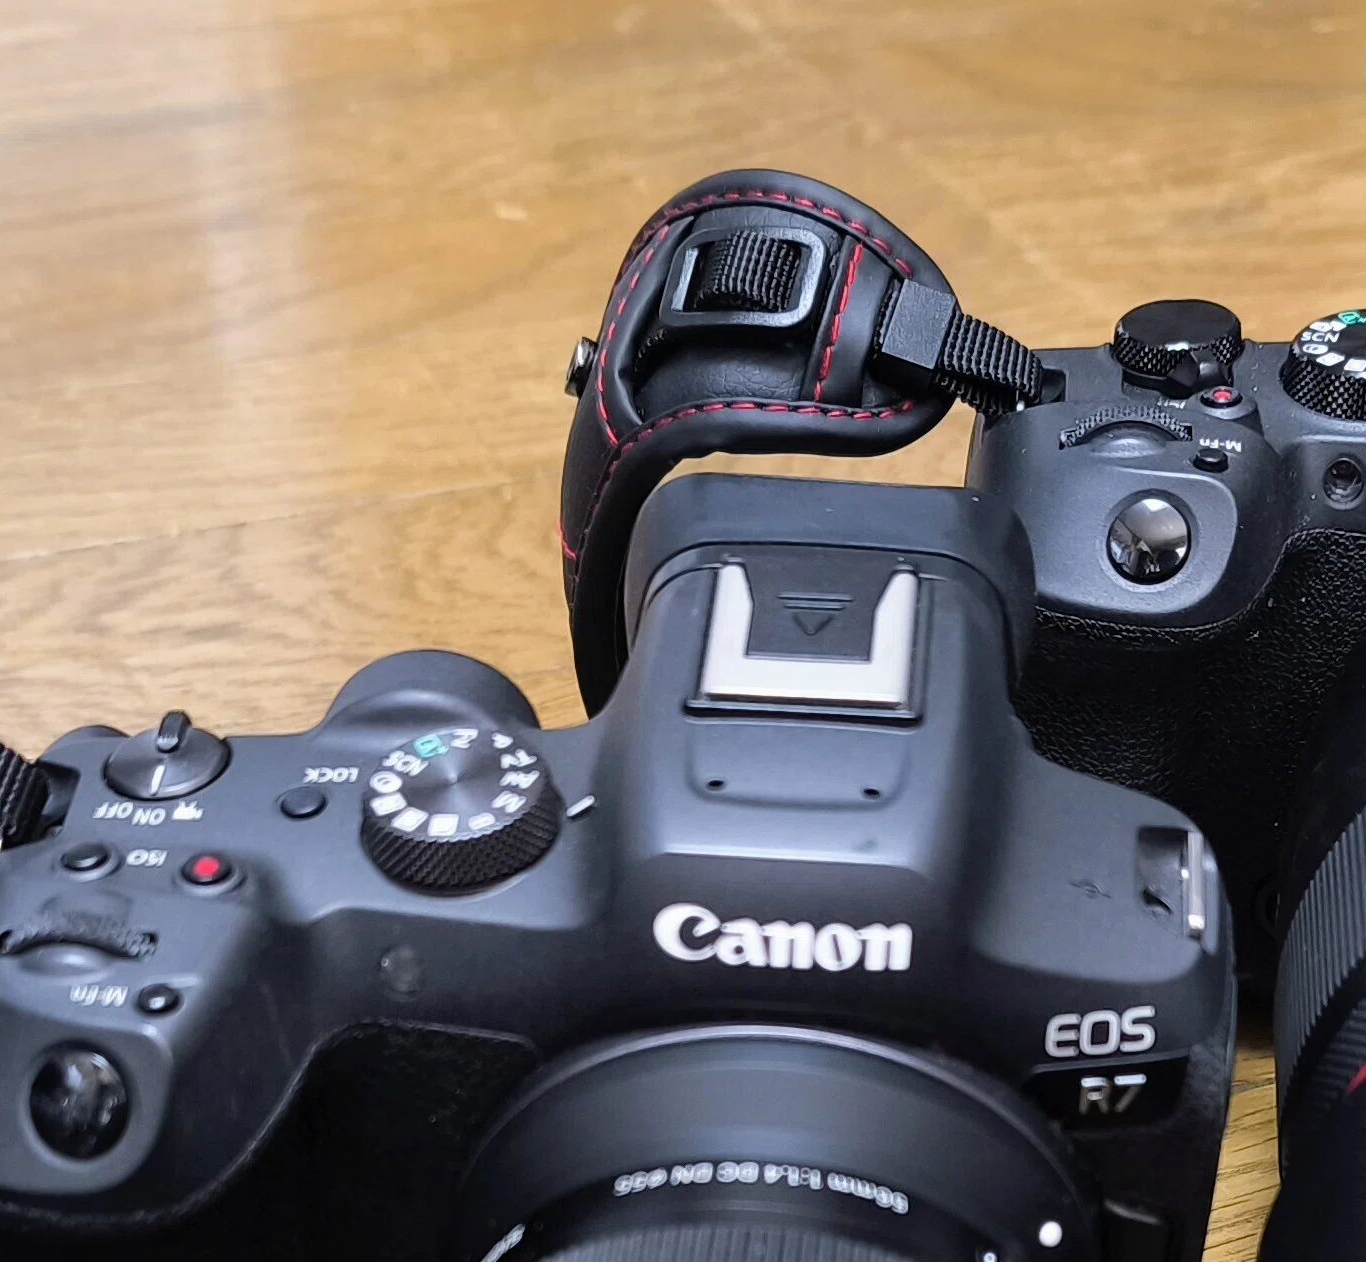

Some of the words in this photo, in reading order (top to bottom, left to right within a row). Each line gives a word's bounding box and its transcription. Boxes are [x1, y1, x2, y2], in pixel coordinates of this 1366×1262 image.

[1199, 437, 1243, 452] M-Fn
[302, 767, 360, 784] LOCK
[92, 801, 134, 820] OFF
[131, 807, 167, 827] ON
[125, 848, 168, 867] ISO
[653, 901, 913, 972] Canon
[1045, 1005, 1156, 1058] EOS
[1078, 1073, 1148, 1115] R7
[716, 1160, 760, 1184] DC
